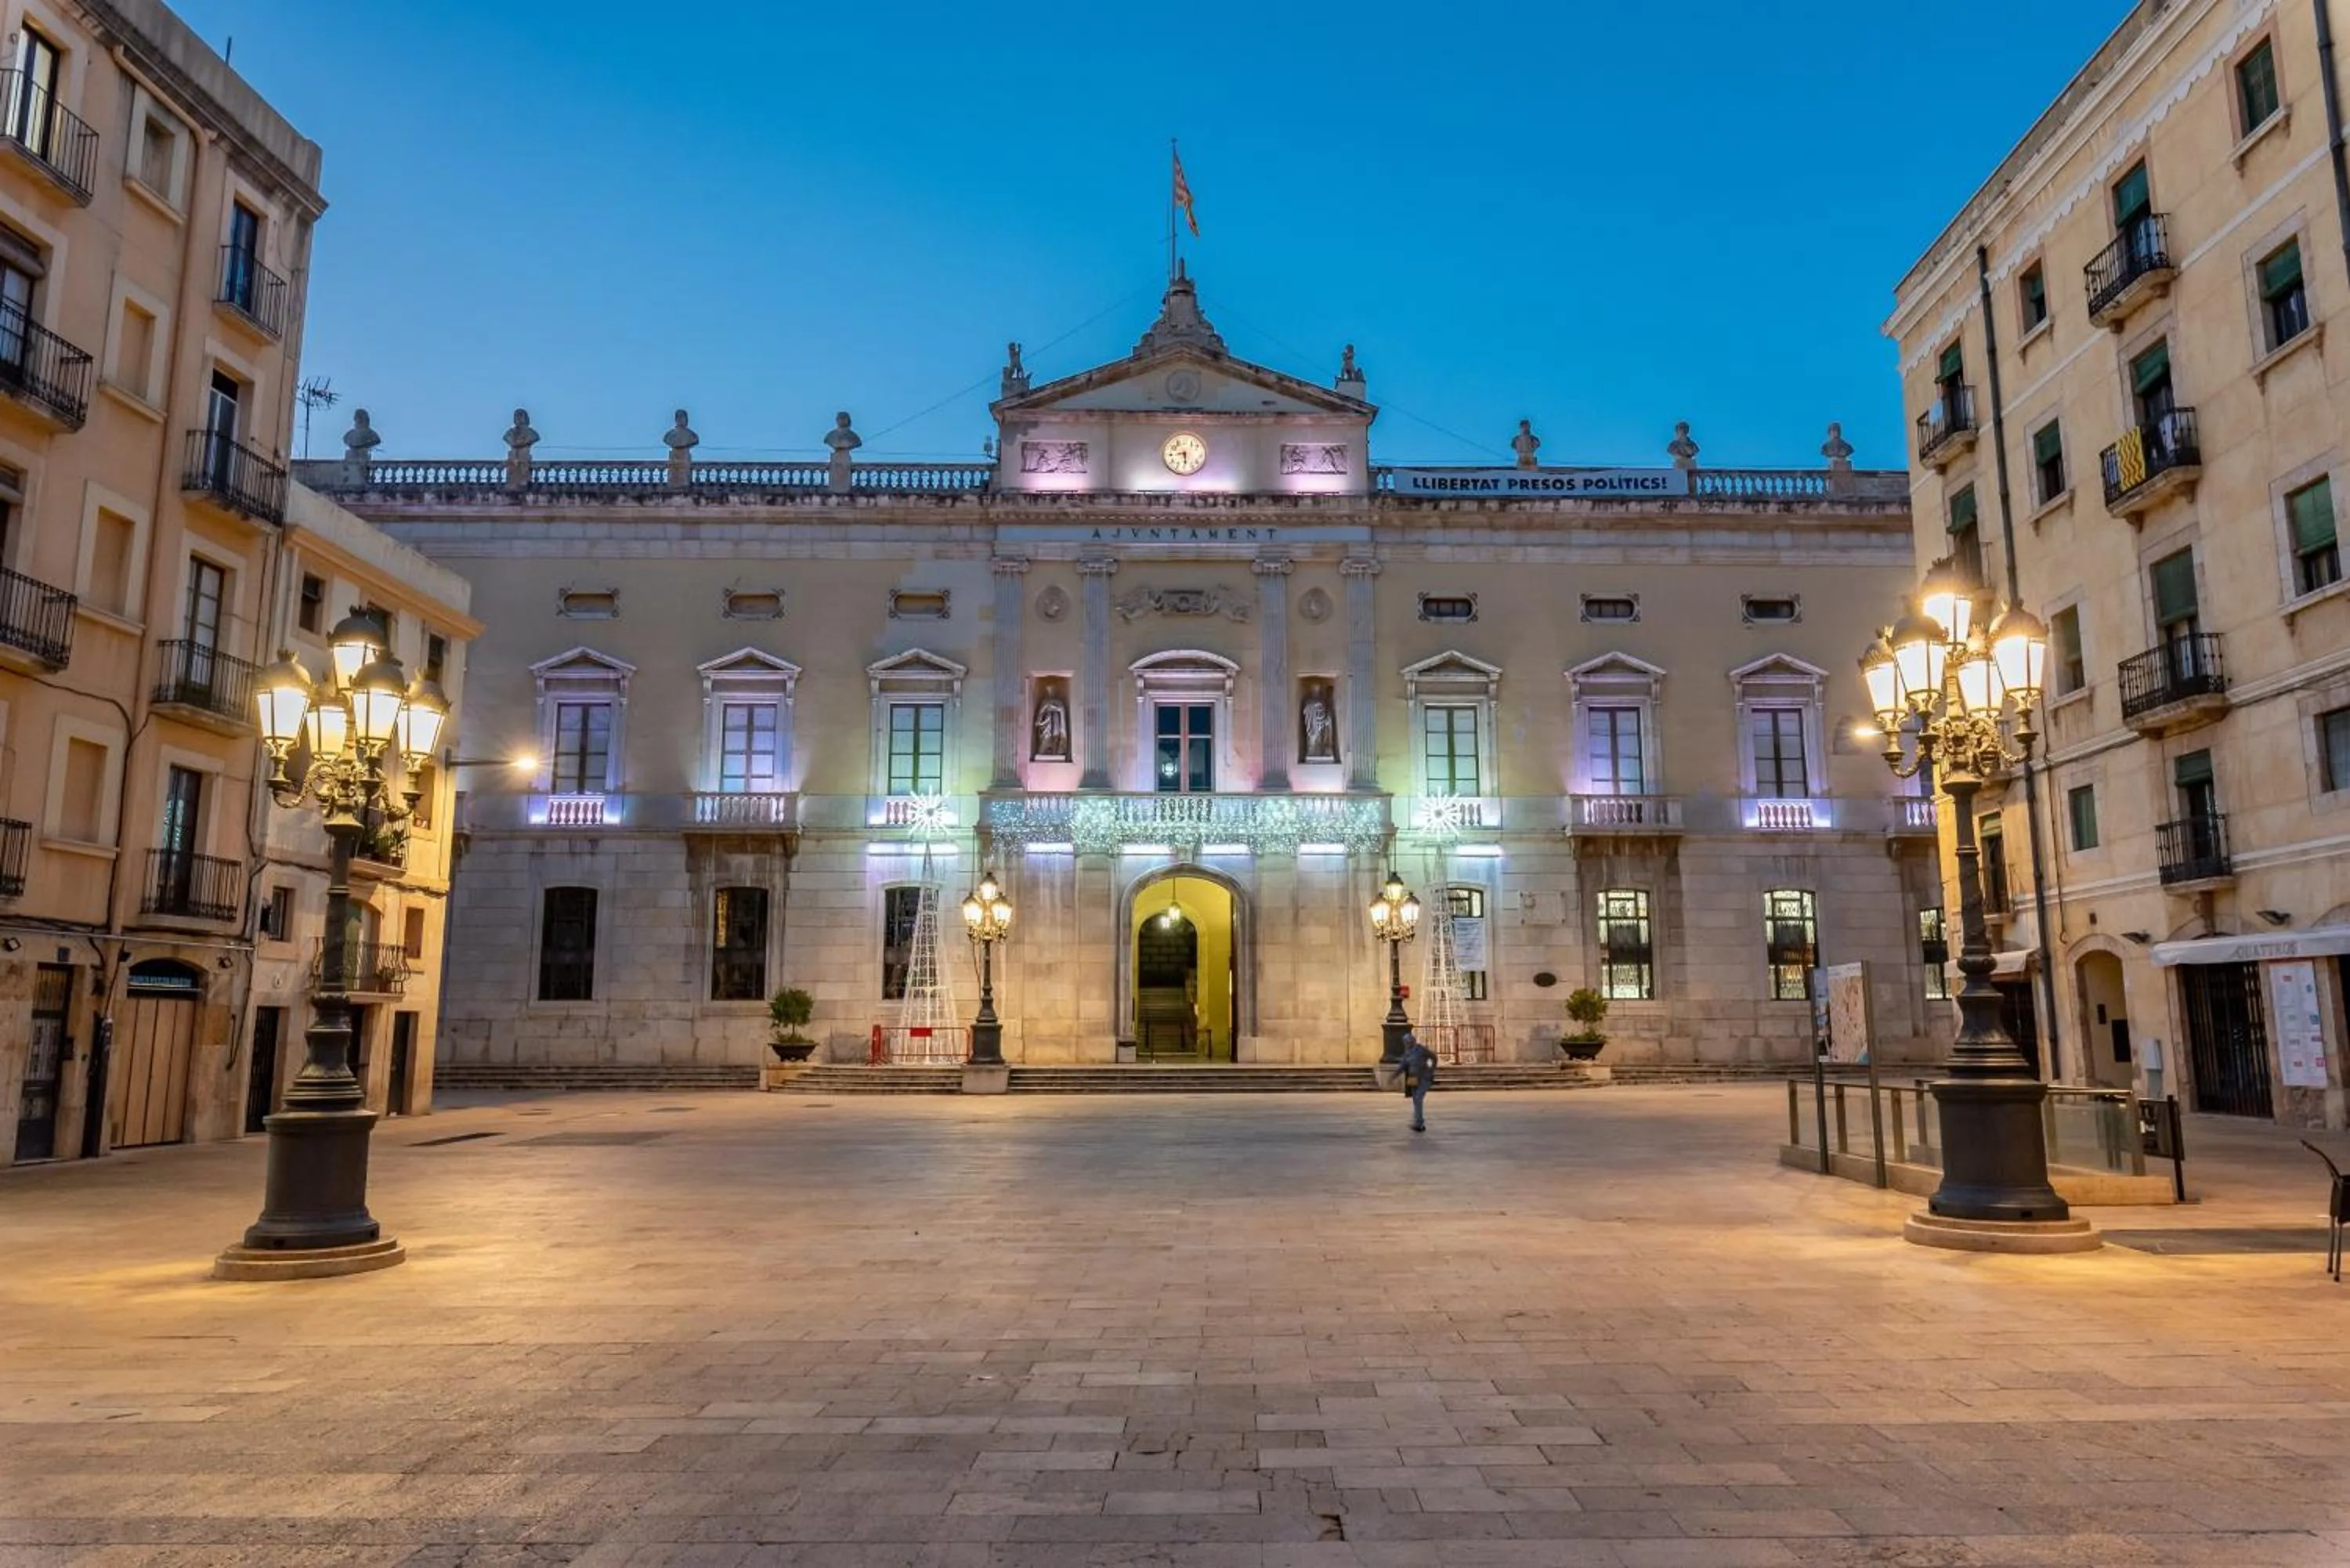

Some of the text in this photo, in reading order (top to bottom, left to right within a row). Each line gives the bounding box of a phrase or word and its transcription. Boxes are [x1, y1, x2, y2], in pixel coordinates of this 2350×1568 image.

[1412, 475, 1668, 491] LLIBERTAT PRESOS POLÍTICS!
